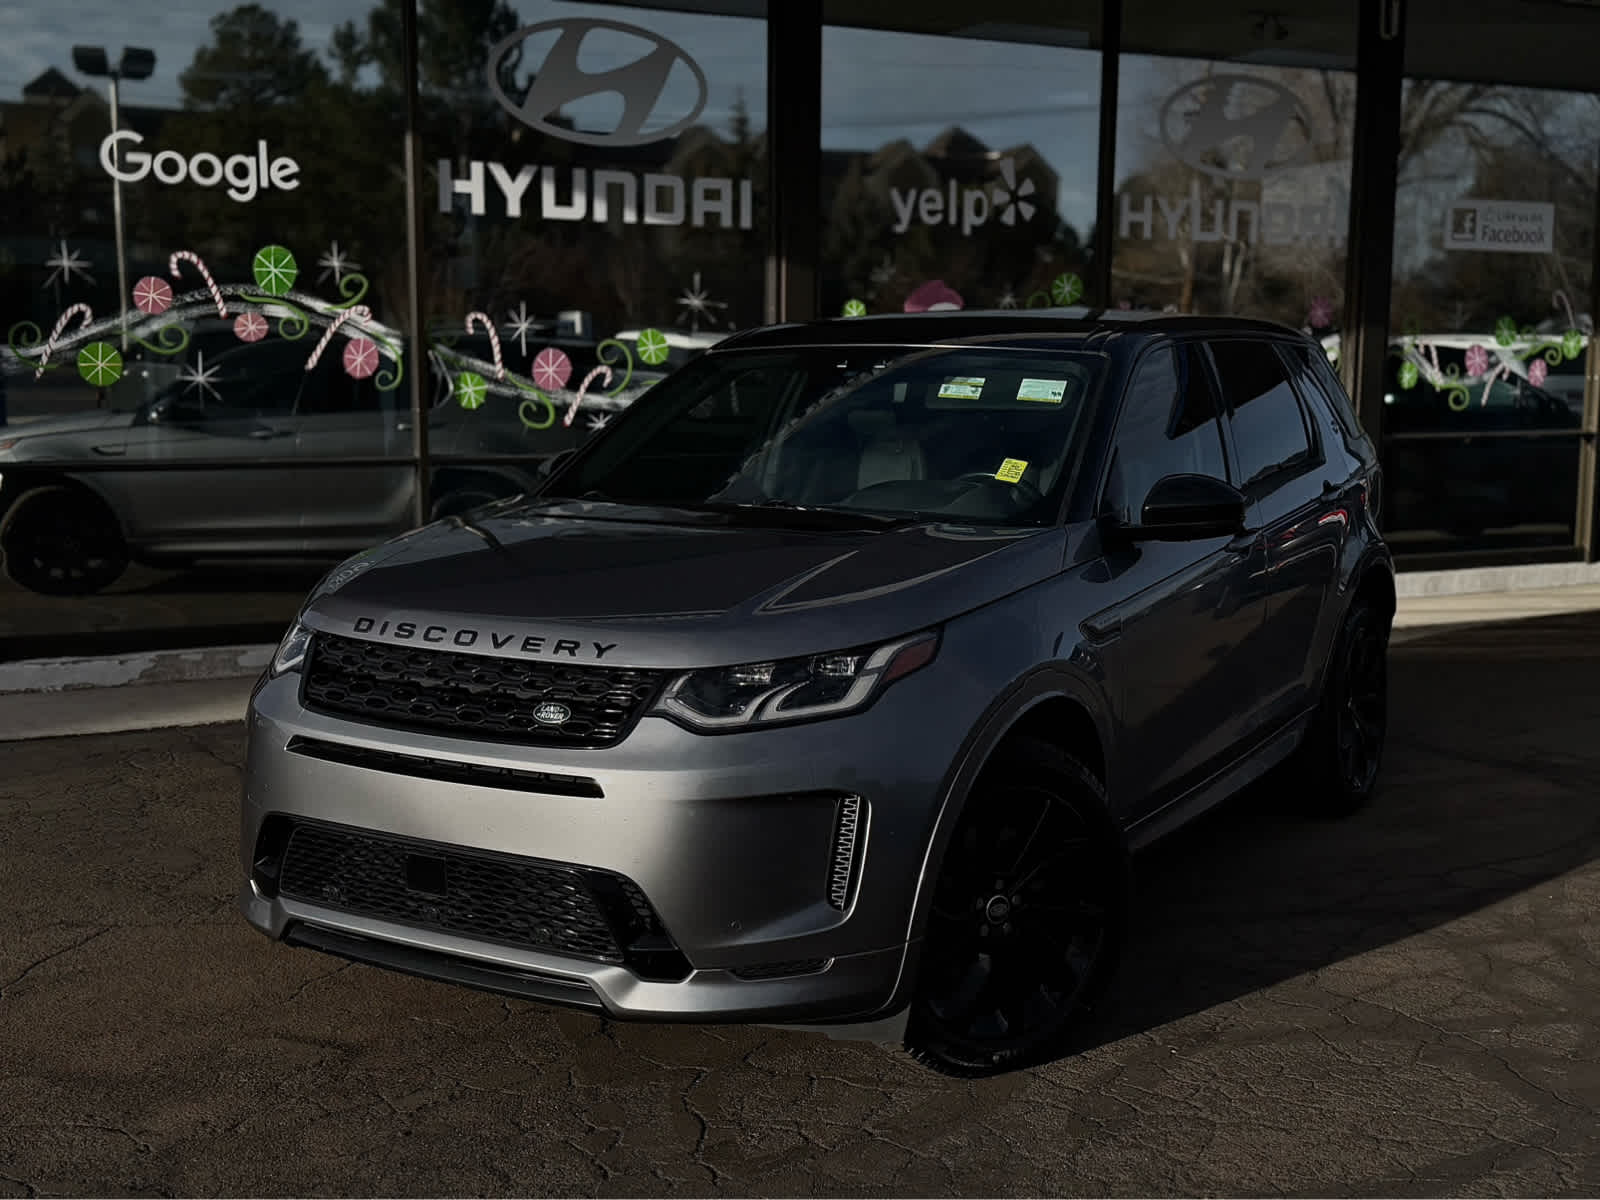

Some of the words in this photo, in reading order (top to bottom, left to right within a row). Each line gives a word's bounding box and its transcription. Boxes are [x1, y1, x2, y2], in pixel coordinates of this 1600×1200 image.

[99, 129, 300, 203] Google
[437, 157, 752, 230] HYUNDAI
[889, 177, 989, 237] yelp
[1481, 224, 1545, 243] Facebook
[353, 616, 618, 659] DISCOVERY
